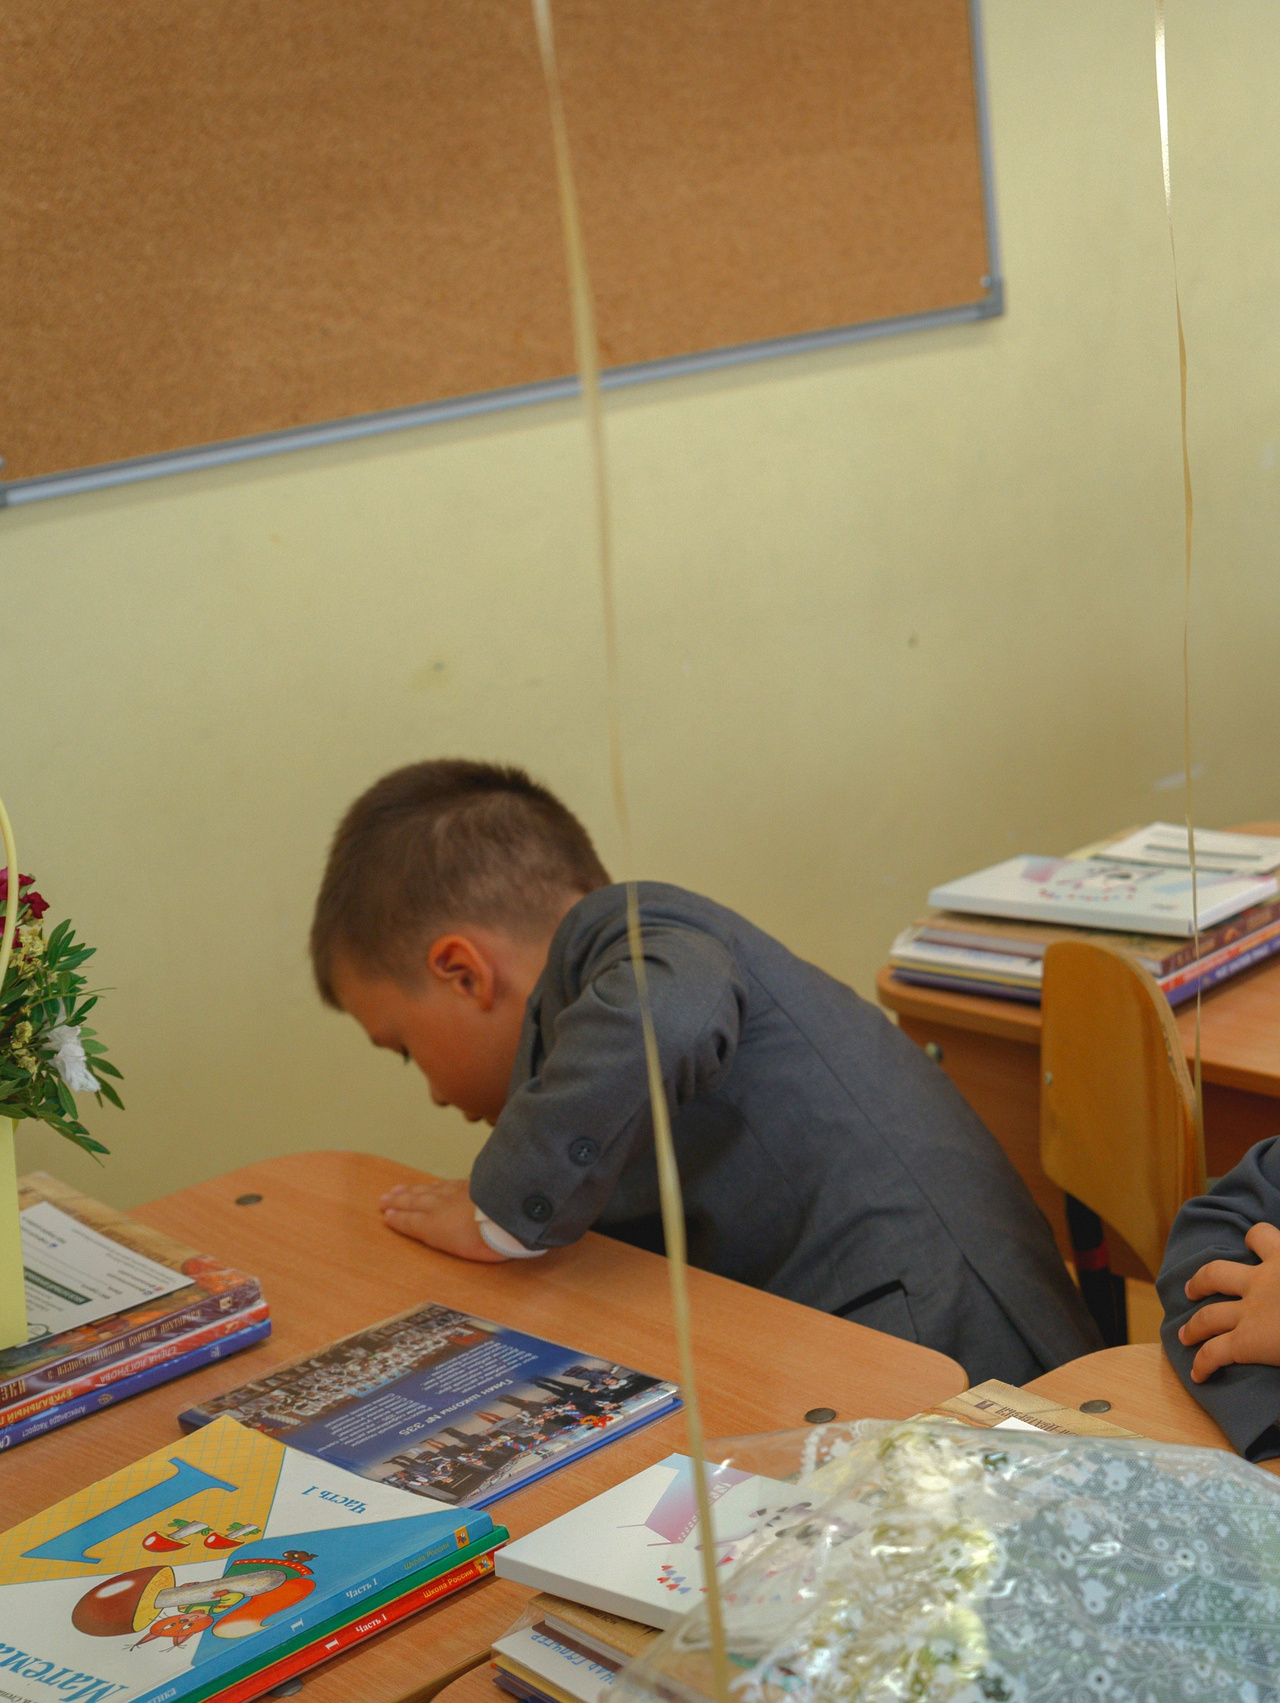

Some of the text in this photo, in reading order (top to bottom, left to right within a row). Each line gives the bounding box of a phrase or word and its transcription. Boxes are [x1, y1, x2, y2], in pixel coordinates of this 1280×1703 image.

[49, 1406, 86, 1426] Александра
[398, 1421, 425, 1437] 335
[301, 1485, 369, 1515] Часть 1
[345, 1582, 372, 1599] Часть
[372, 1577, 379, 1586] 1
[403, 1554, 427, 1571] Школа
[426, 1542, 450, 1559] России
[355, 1617, 382, 1634] Часть
[381, 1612, 388, 1622] 1
[422, 1582, 448, 1599] Школа
[447, 1569, 474, 1586] России
